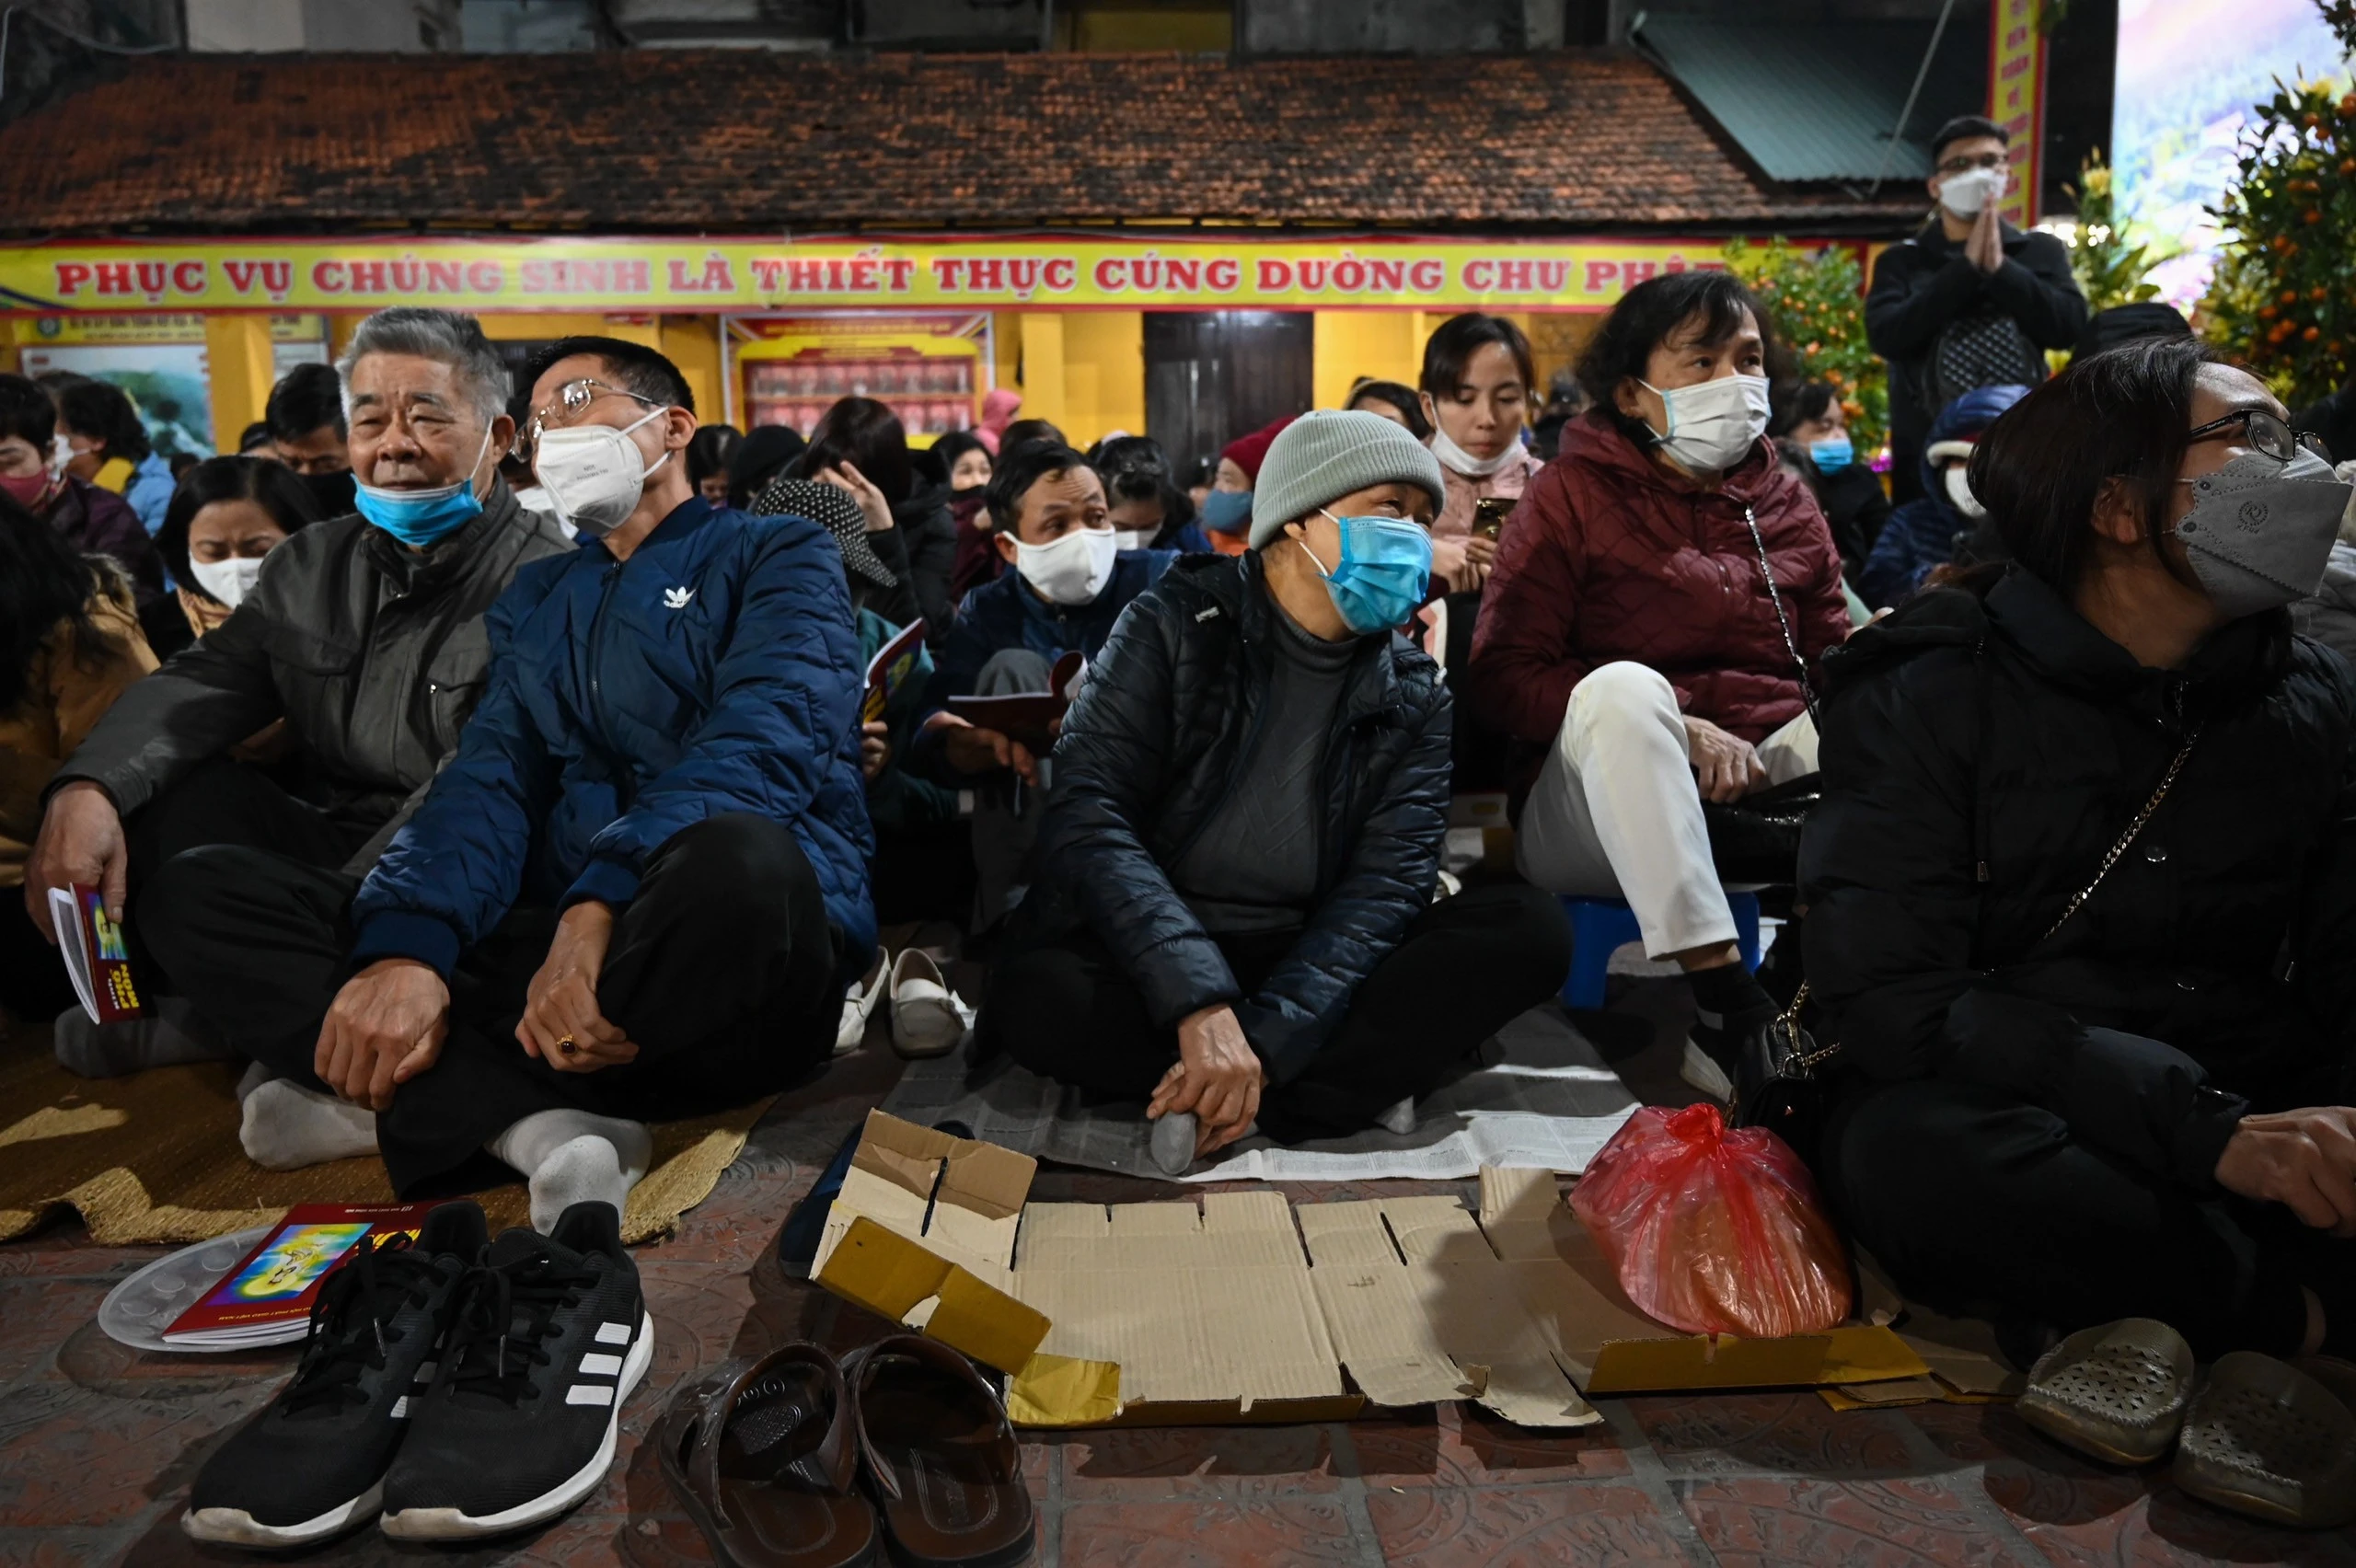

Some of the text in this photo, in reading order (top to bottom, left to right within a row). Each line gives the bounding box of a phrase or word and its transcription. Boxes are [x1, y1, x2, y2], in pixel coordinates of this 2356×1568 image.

[55, 261, 205, 302] PHỤC
[224, 261, 292, 301] VỤ
[312, 254, 502, 293] CHÚNG
[522, 259, 650, 293] SINH
[667, 252, 734, 292] LÀ
[751, 248, 914, 292] THIẾT
[932, 259, 1075, 297] THỰC
[1095, 252, 1239, 292] CÚNG
[1257, 251, 1443, 292] DƯỜNG
[1462, 259, 1571, 292] CHƯ
